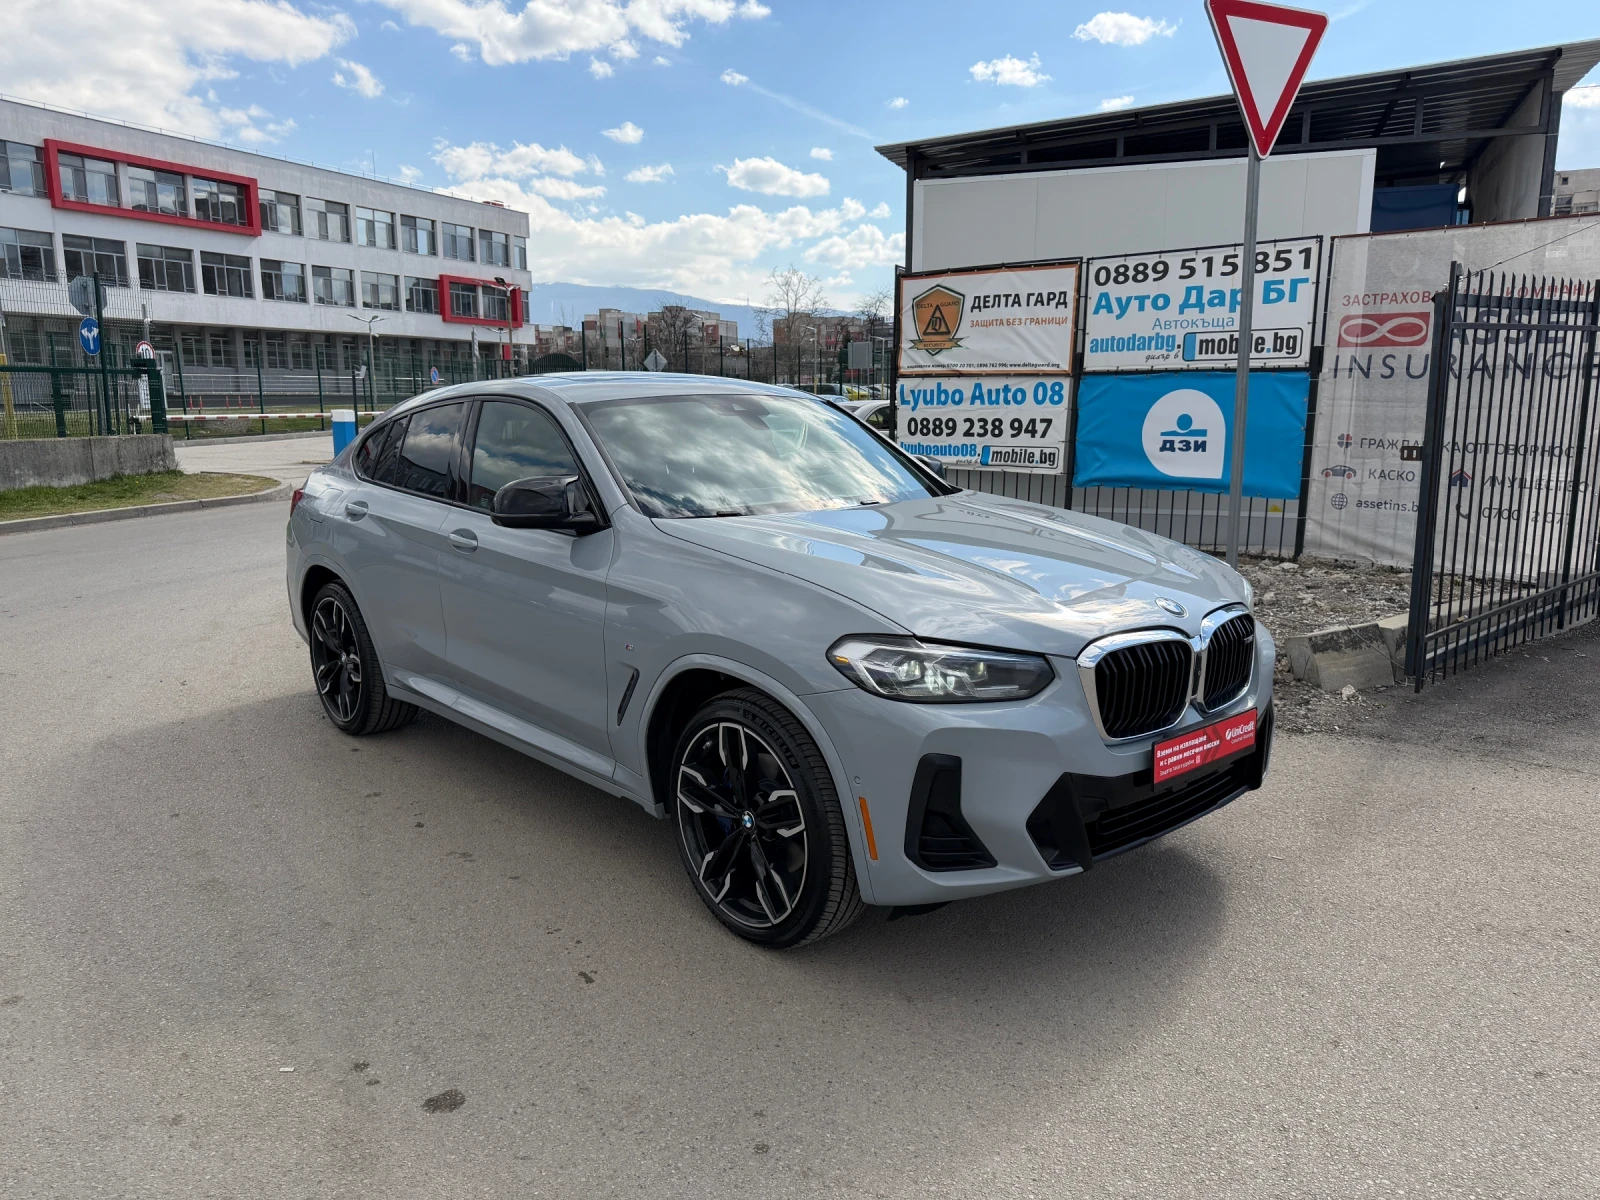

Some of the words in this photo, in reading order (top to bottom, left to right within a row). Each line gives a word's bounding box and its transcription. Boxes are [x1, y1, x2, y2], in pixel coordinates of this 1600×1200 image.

[1094, 260, 1169, 287] 0889
[1179, 253, 1239, 280] 515
[1254, 247, 1312, 274] 851
[940, 300, 960, 308] GUARD
[970, 293, 1022, 313] ДЕЛТА
[1026, 291, 1068, 309] ГАРД
[1092, 290, 1171, 320] Ауто
[1179, 285, 1243, 315] Дар
[1262, 277, 1310, 305] БГ
[970, 318, 1005, 329] ЗАЩИТА
[1006, 318, 1023, 327] БЕЗ
[1024, 316, 1068, 327] ГРАНИЦИ
[1152, 316, 1235, 331] Автокъща
[900, 382, 964, 411] Lyubo
[970, 382, 1027, 406] Auto
[1033, 381, 1064, 406] 08
[907, 416, 957, 437] 0889
[962, 417, 1004, 438] 238
[1009, 417, 1053, 439] 947
[991, 448, 1056, 466] mobile.bg
[1368, 469, 1416, 482] КАСКО
[1356, 498, 1420, 513] assetins.b
[1231, 720, 1255, 738] UniCredit
[754, 717, 798, 769] MICHELIN
